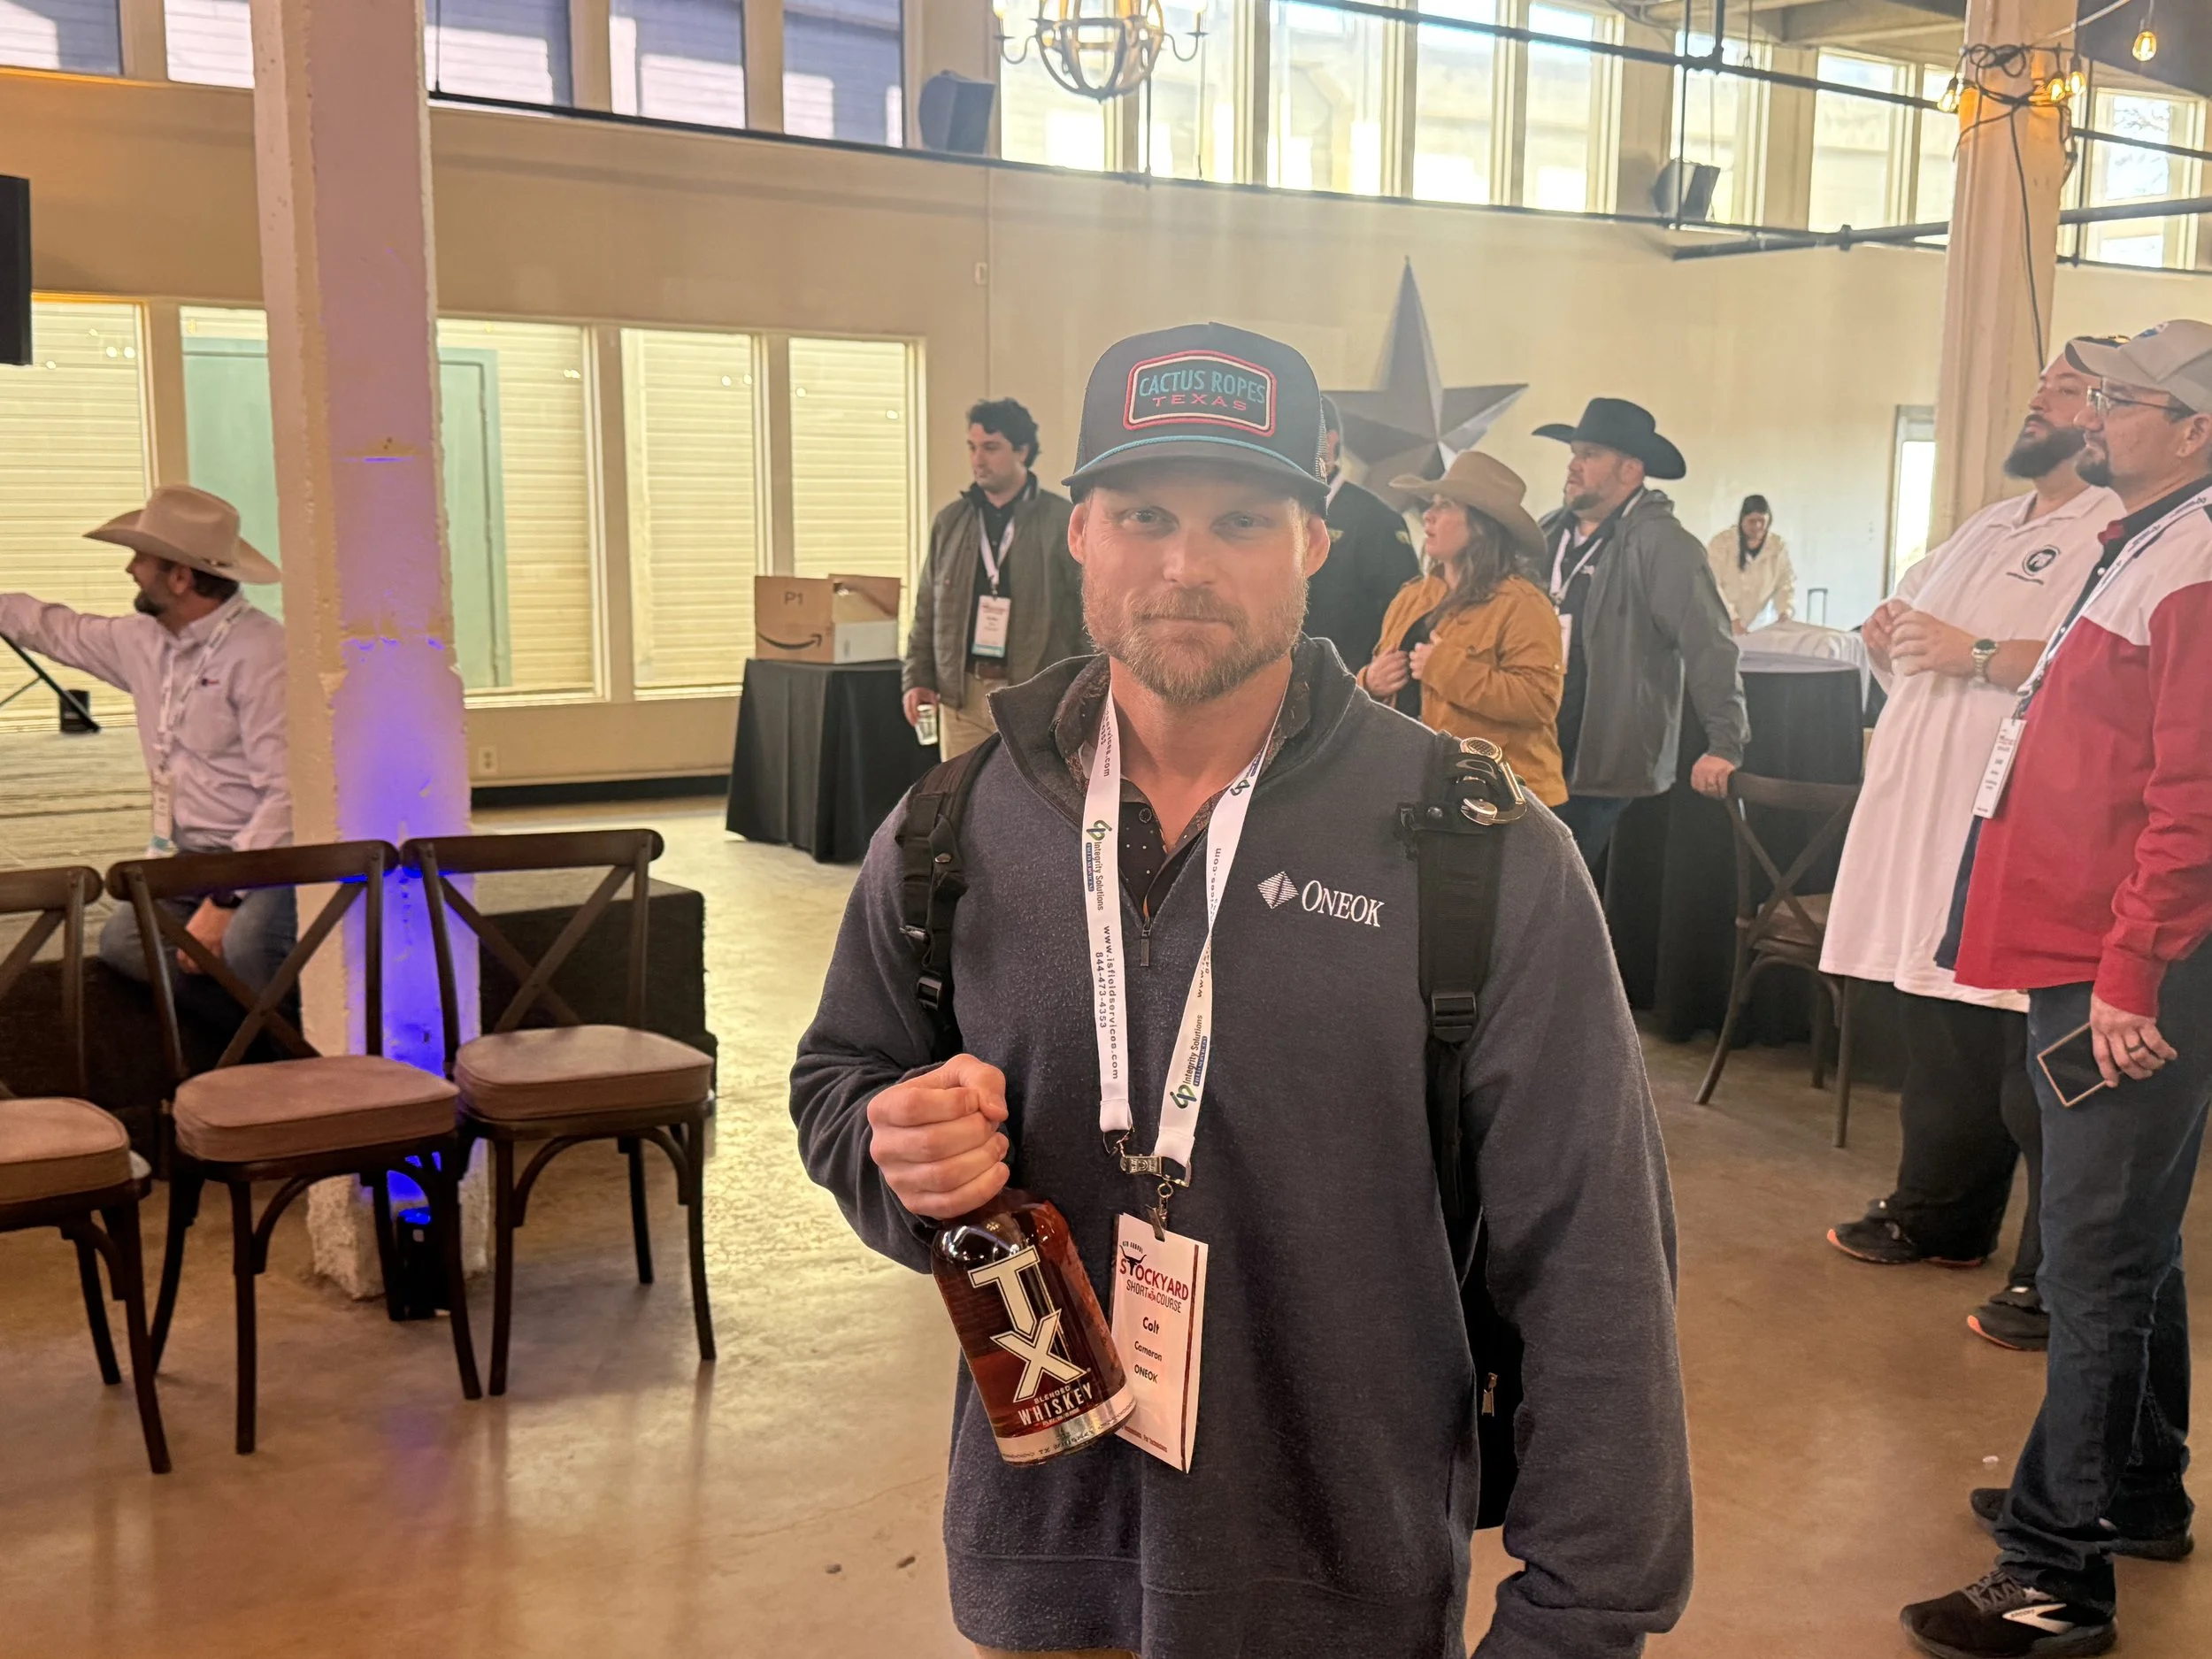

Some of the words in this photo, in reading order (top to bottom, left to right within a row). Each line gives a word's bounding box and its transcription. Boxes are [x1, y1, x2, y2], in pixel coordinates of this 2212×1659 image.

[1139, 370, 1206, 397] CACTUS
[1211, 372, 1266, 403] ROPES
[1152, 394, 1247, 411] TEXAS
[1092, 841, 1103, 873] Integrity
[1095, 875, 1105, 911] Solutions
[1302, 879, 1385, 927] ONEOK
[1095, 952, 1107, 1028] 844-473-4353
[1183, 1052, 1197, 1085] Integrity
[1191, 1015, 1203, 1051] Solutions
[1119, 1256, 1189, 1301] STOCKYARD
[1126, 1279, 1148, 1298] SHORT
[1156, 1292, 1182, 1313] COURSE
[1142, 1317, 1160, 1334] Colt
[1134, 1340, 1163, 1362] Cameron
[1134, 1363, 1158, 1384] ONEOK
[1018, 1382, 1093, 1426] WHISKEY
